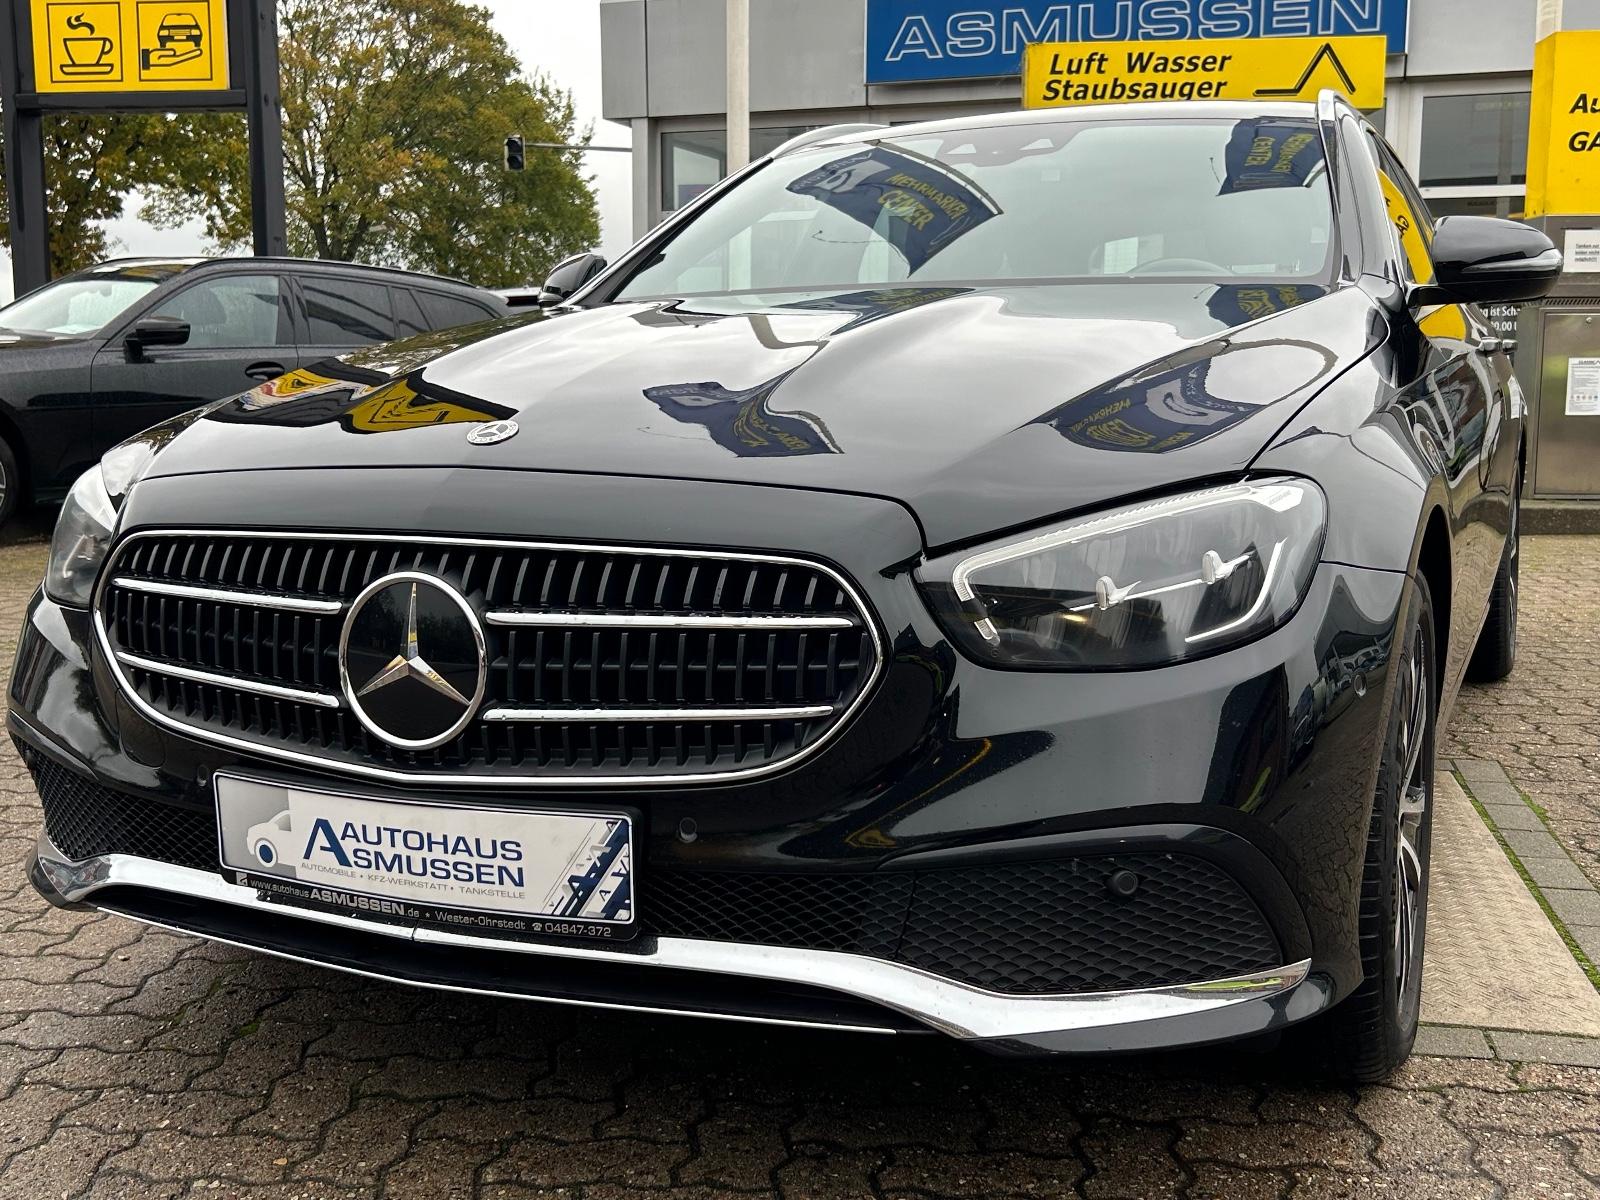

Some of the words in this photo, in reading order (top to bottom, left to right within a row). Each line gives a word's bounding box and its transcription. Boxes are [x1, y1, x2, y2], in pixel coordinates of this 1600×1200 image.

[884, 0, 1381, 62] ASMUSSEN
[1049, 52, 1108, 75] Luft
[1126, 52, 1232, 74] Wasser
[1042, 79, 1228, 101] Staubsauger
[1490, 305, 1501, 317] ist
[340, 821, 523, 862] AUTOHAUS
[300, 862, 357, 879] AUTOMOBILE
[367, 874, 449, 892] KFZ-WERKSTATT
[459, 885, 526, 900] TANKSTELLE
[434, 910, 526, 931] Wester-Ohrstedt
[544, 922, 612, 938] 04847-372
